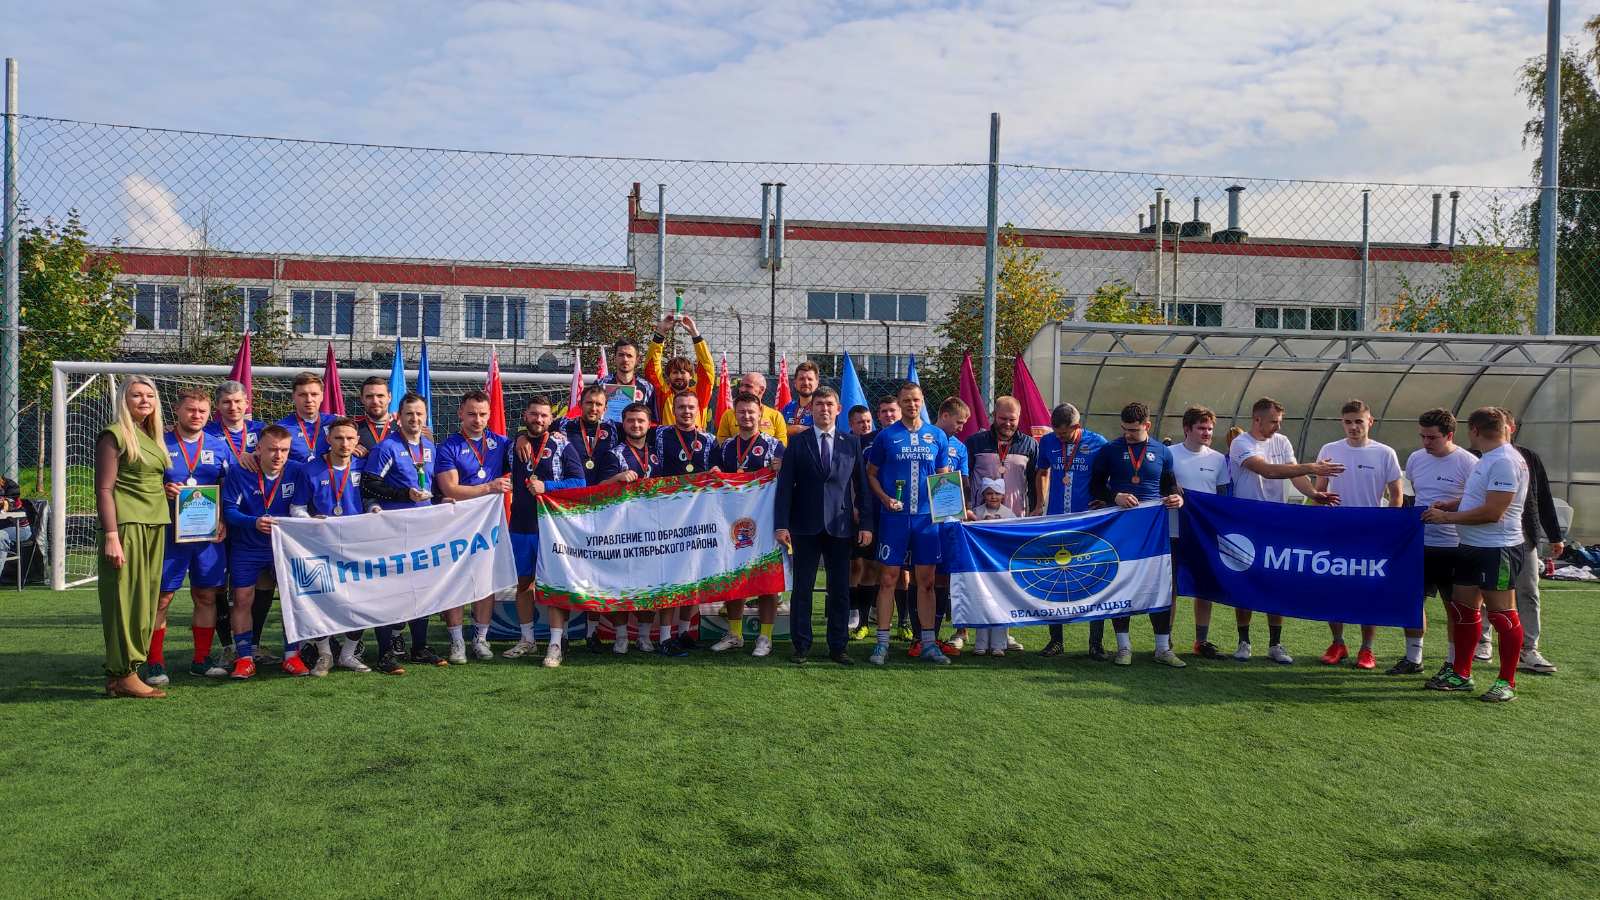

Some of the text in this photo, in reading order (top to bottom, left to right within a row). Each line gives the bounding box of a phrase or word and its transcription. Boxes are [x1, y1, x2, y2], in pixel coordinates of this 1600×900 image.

[1057, 456, 1085, 464] BEERO
[586, 523, 718, 547] УПРАВЛЕНИЕ ПО ОБРАЗОВАНИЮ
[623, 541, 685, 558] ОКТЯБРЬСКОГО
[686, 537, 718, 551] РАЙОНА
[1263, 545, 1389, 577] МТбанк
[1010, 599, 1132, 619] БЕЛАЭРАНАВІГАЦЫЯ
